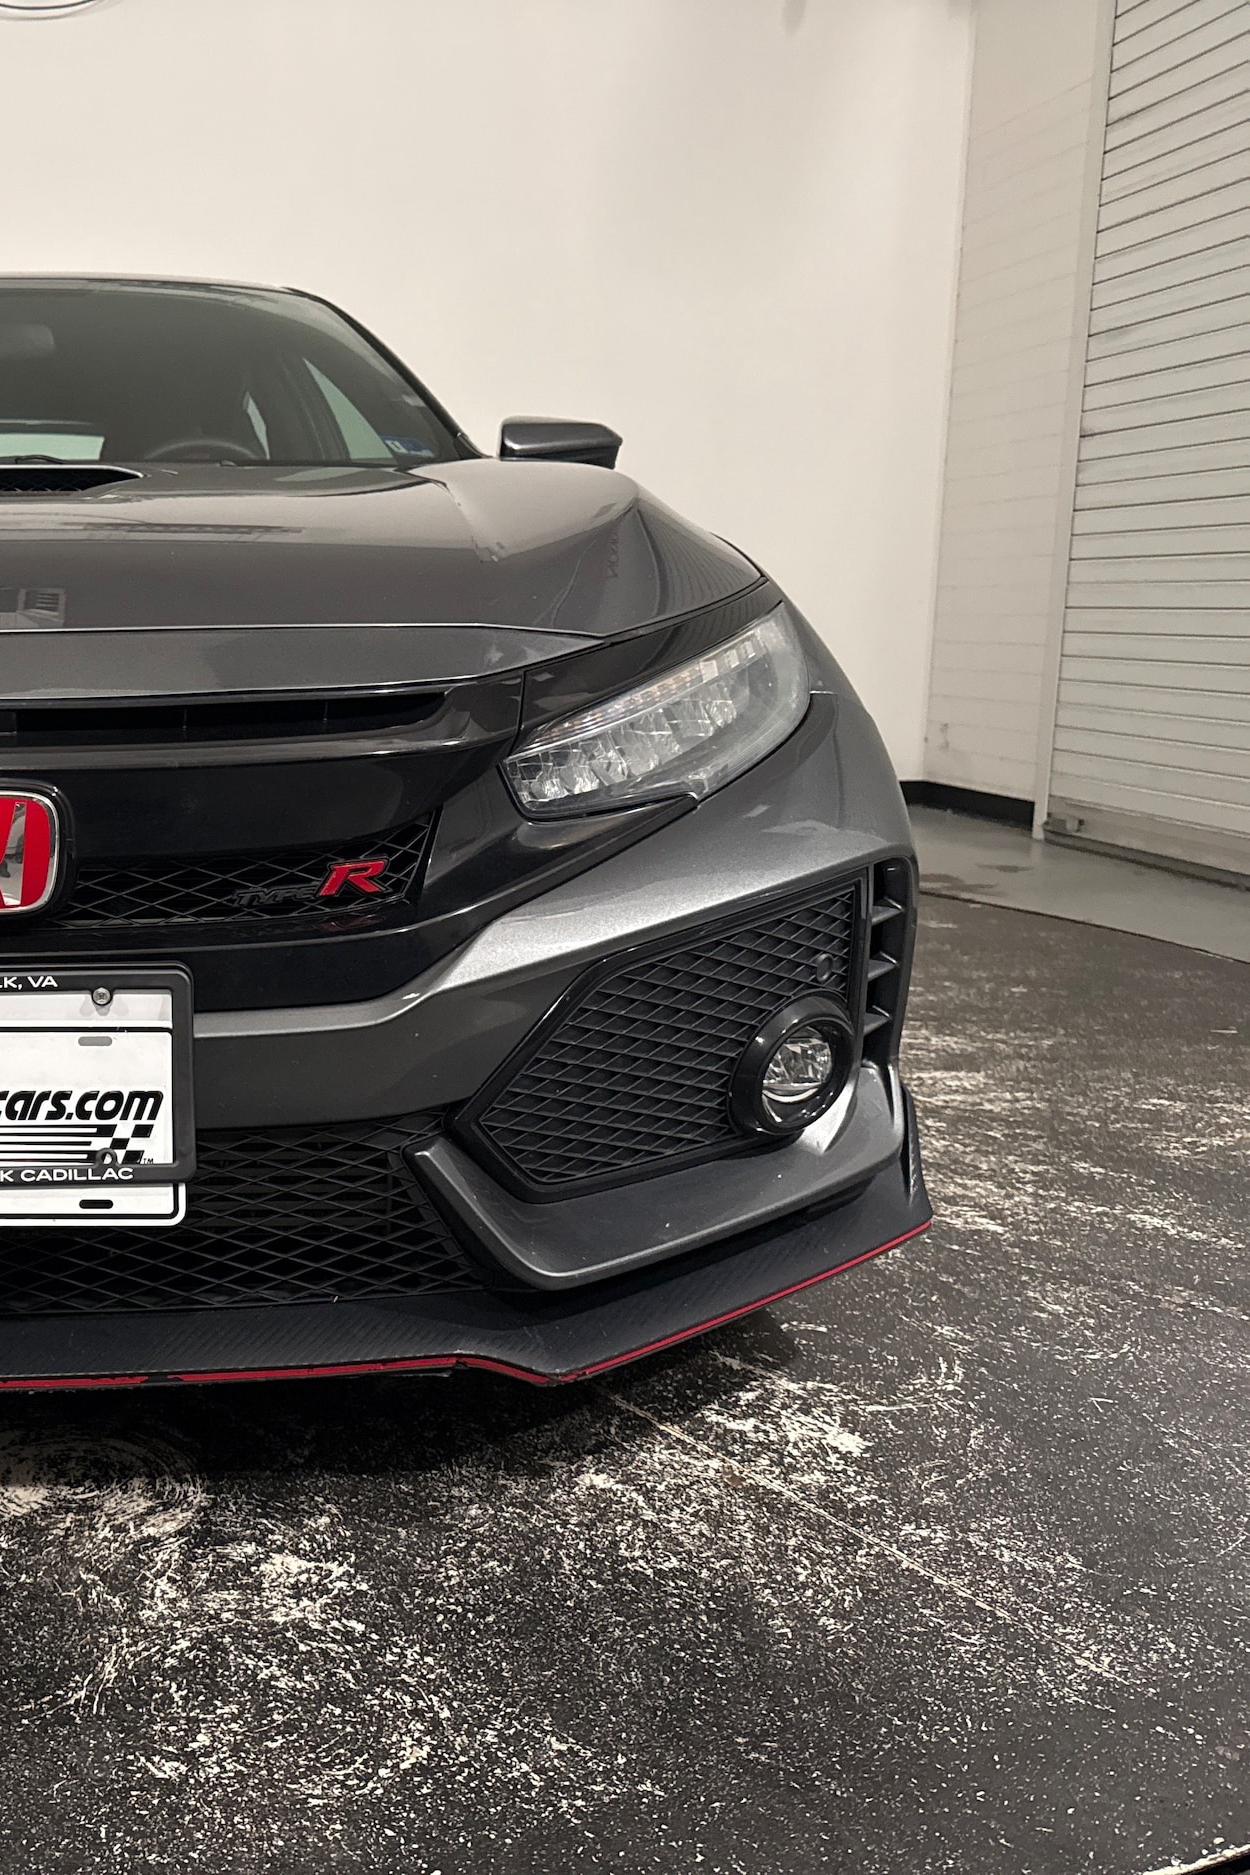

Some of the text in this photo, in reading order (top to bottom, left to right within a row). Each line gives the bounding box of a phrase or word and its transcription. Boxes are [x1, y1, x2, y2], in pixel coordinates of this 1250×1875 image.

[236, 857, 390, 905] TYPE R
[27, 976, 59, 988] VA
[143, 1157, 154, 1165] TM
[20, 1166, 134, 1183] CADILLAC
